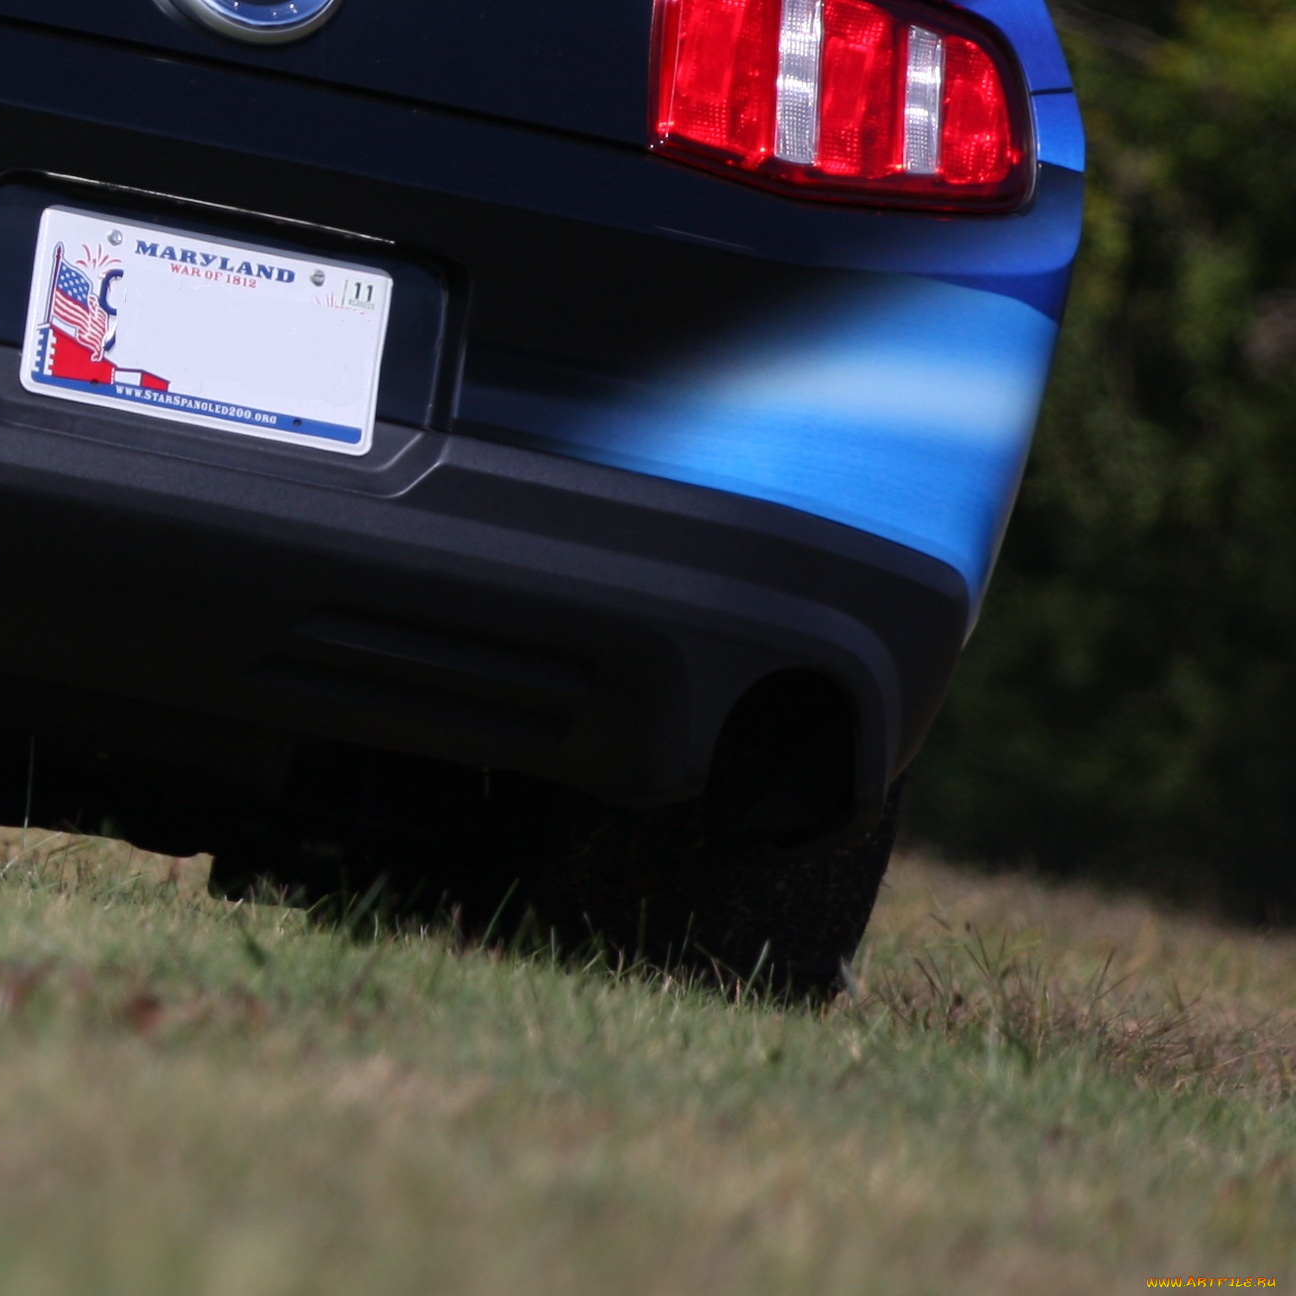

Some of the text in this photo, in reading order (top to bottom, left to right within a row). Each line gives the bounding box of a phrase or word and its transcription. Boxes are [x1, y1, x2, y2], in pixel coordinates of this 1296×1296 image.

[135, 239, 296, 284] MARYLAND
[170, 262, 257, 289] WAR OF 1812
[354, 281, 374, 303] 11
